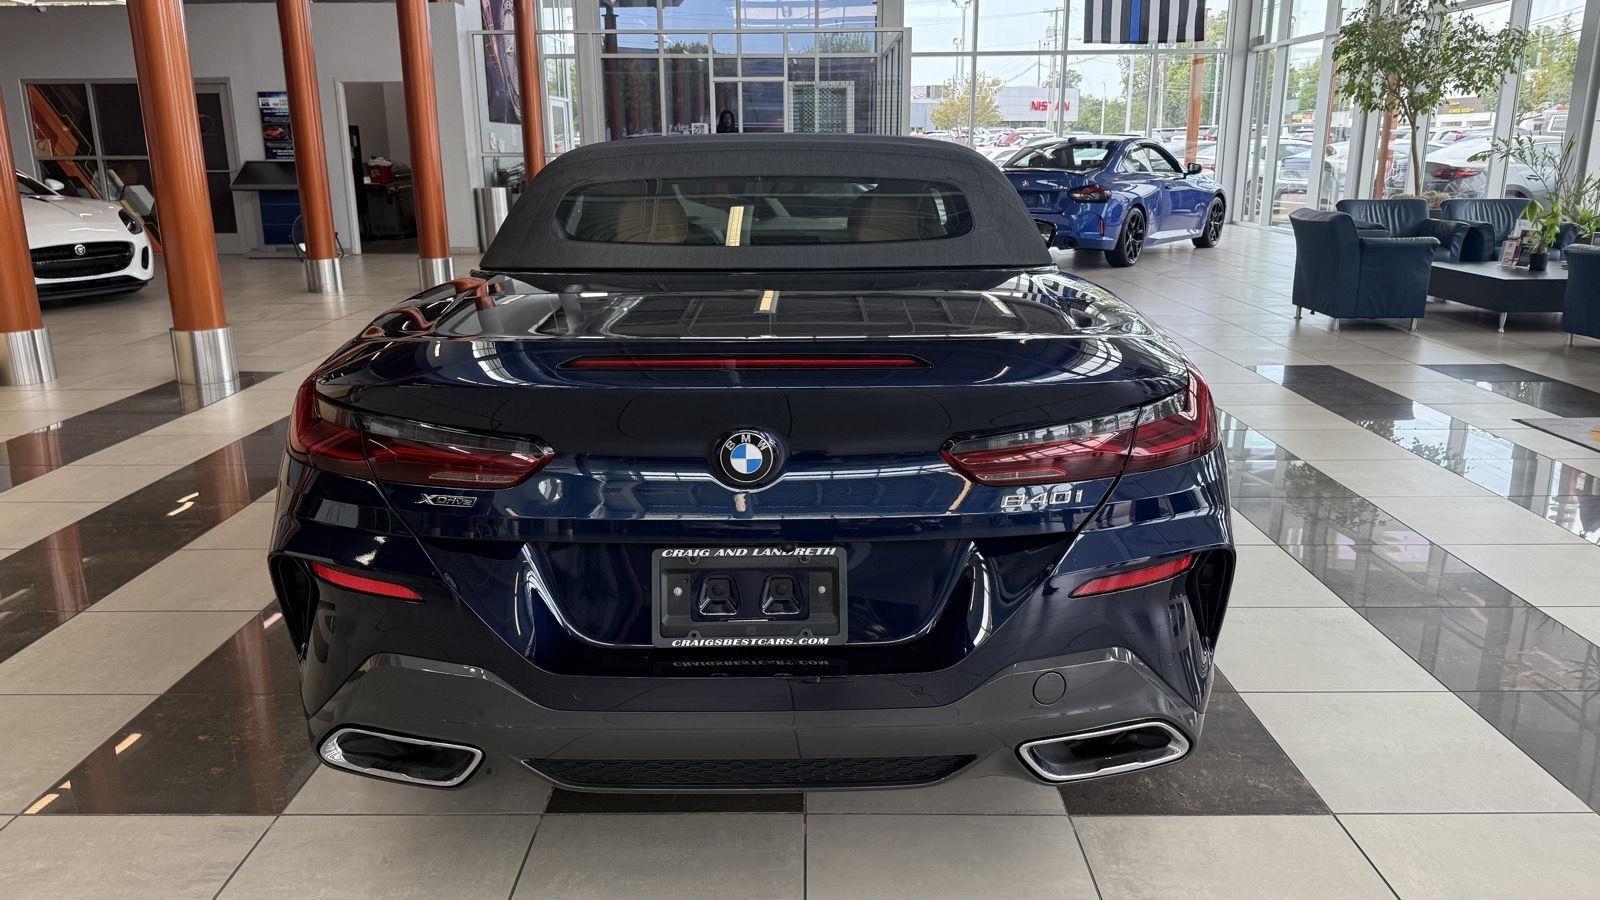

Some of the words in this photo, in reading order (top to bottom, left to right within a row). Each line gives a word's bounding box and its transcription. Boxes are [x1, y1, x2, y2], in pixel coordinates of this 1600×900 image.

[1031, 101, 1070, 111] NISAN
[725, 434, 769, 451] BMW
[1001, 489, 1083, 508] 840i
[661, 548, 711, 557] CRAIG
[713, 548, 748, 557] AND
[672, 637, 829, 647] CRAIGSBESTCARS.COM
